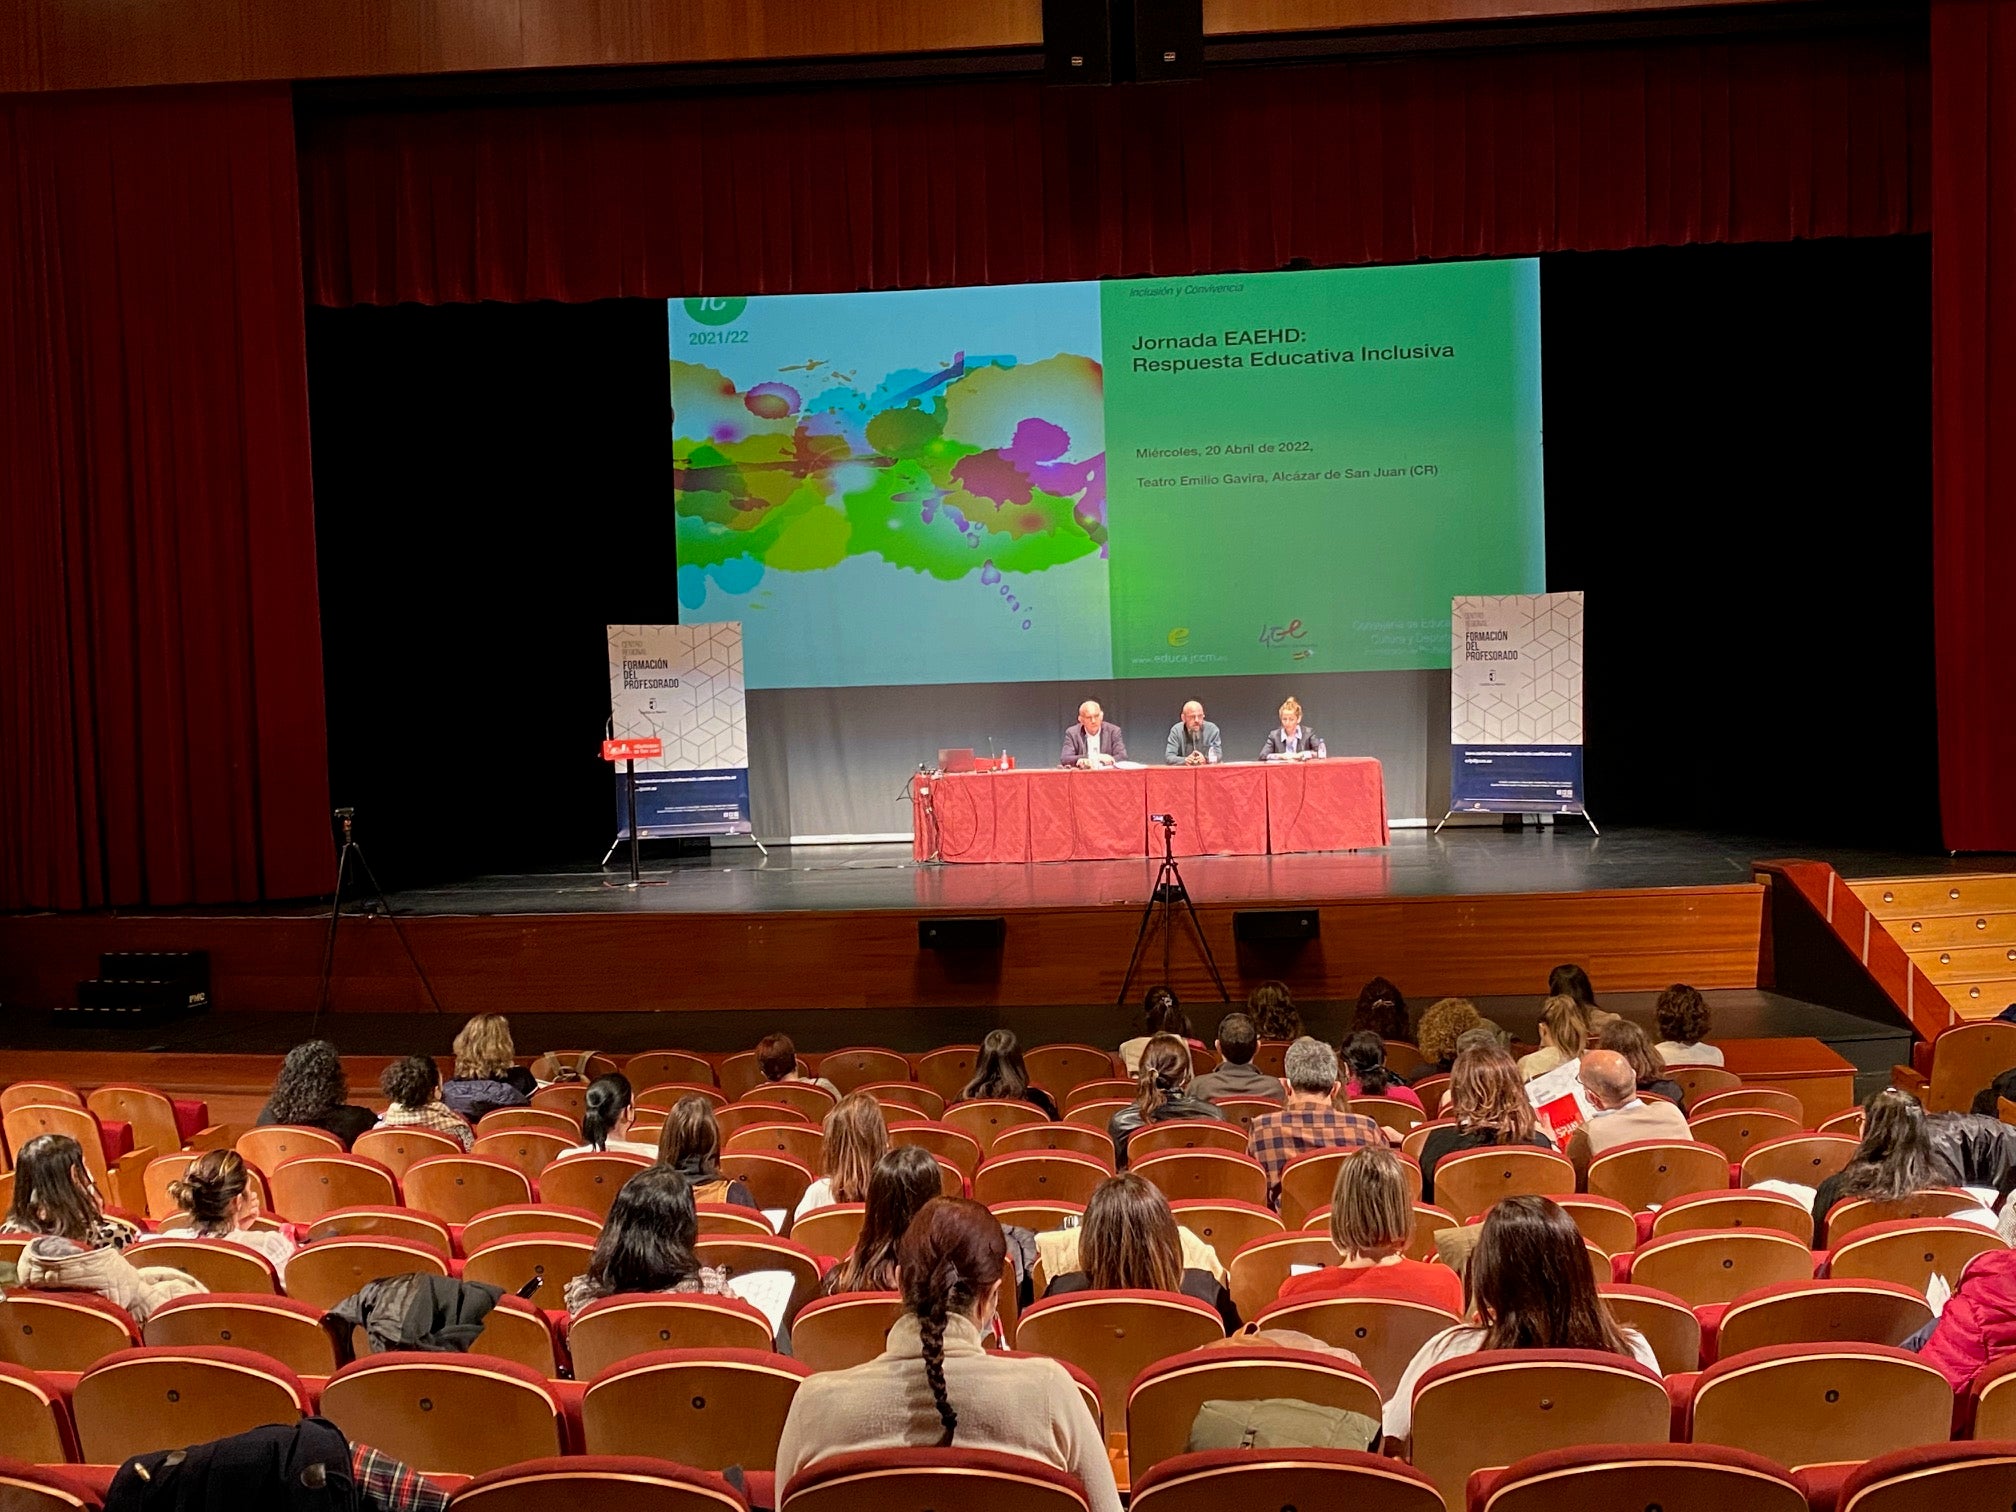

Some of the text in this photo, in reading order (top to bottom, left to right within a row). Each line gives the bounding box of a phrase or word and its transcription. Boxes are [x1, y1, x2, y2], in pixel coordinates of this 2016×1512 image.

[1130, 283, 1244, 298] Inclusión y Convivencia
[689, 330, 749, 346] 2021/22
[1132, 328, 1307, 350] Jornada EAEHD:
[1133, 344, 1454, 374] Respuesta Educativa Inclusiva
[1136, 441, 1313, 459] Miércoles, 20 Abril de 2022,
[1136, 465, 1438, 488] Teatro Emilio Gavira, Alcázar de San Juan (CR)
[1465, 629, 1508, 641] FORMACIÓN
[1465, 641, 1480, 651] DEL
[1465, 650, 1519, 662] PROFESORADO
[622, 657, 669, 670] FORMACIÓN
[623, 670, 638, 680] DEL
[623, 678, 680, 690] PROFESORADO
